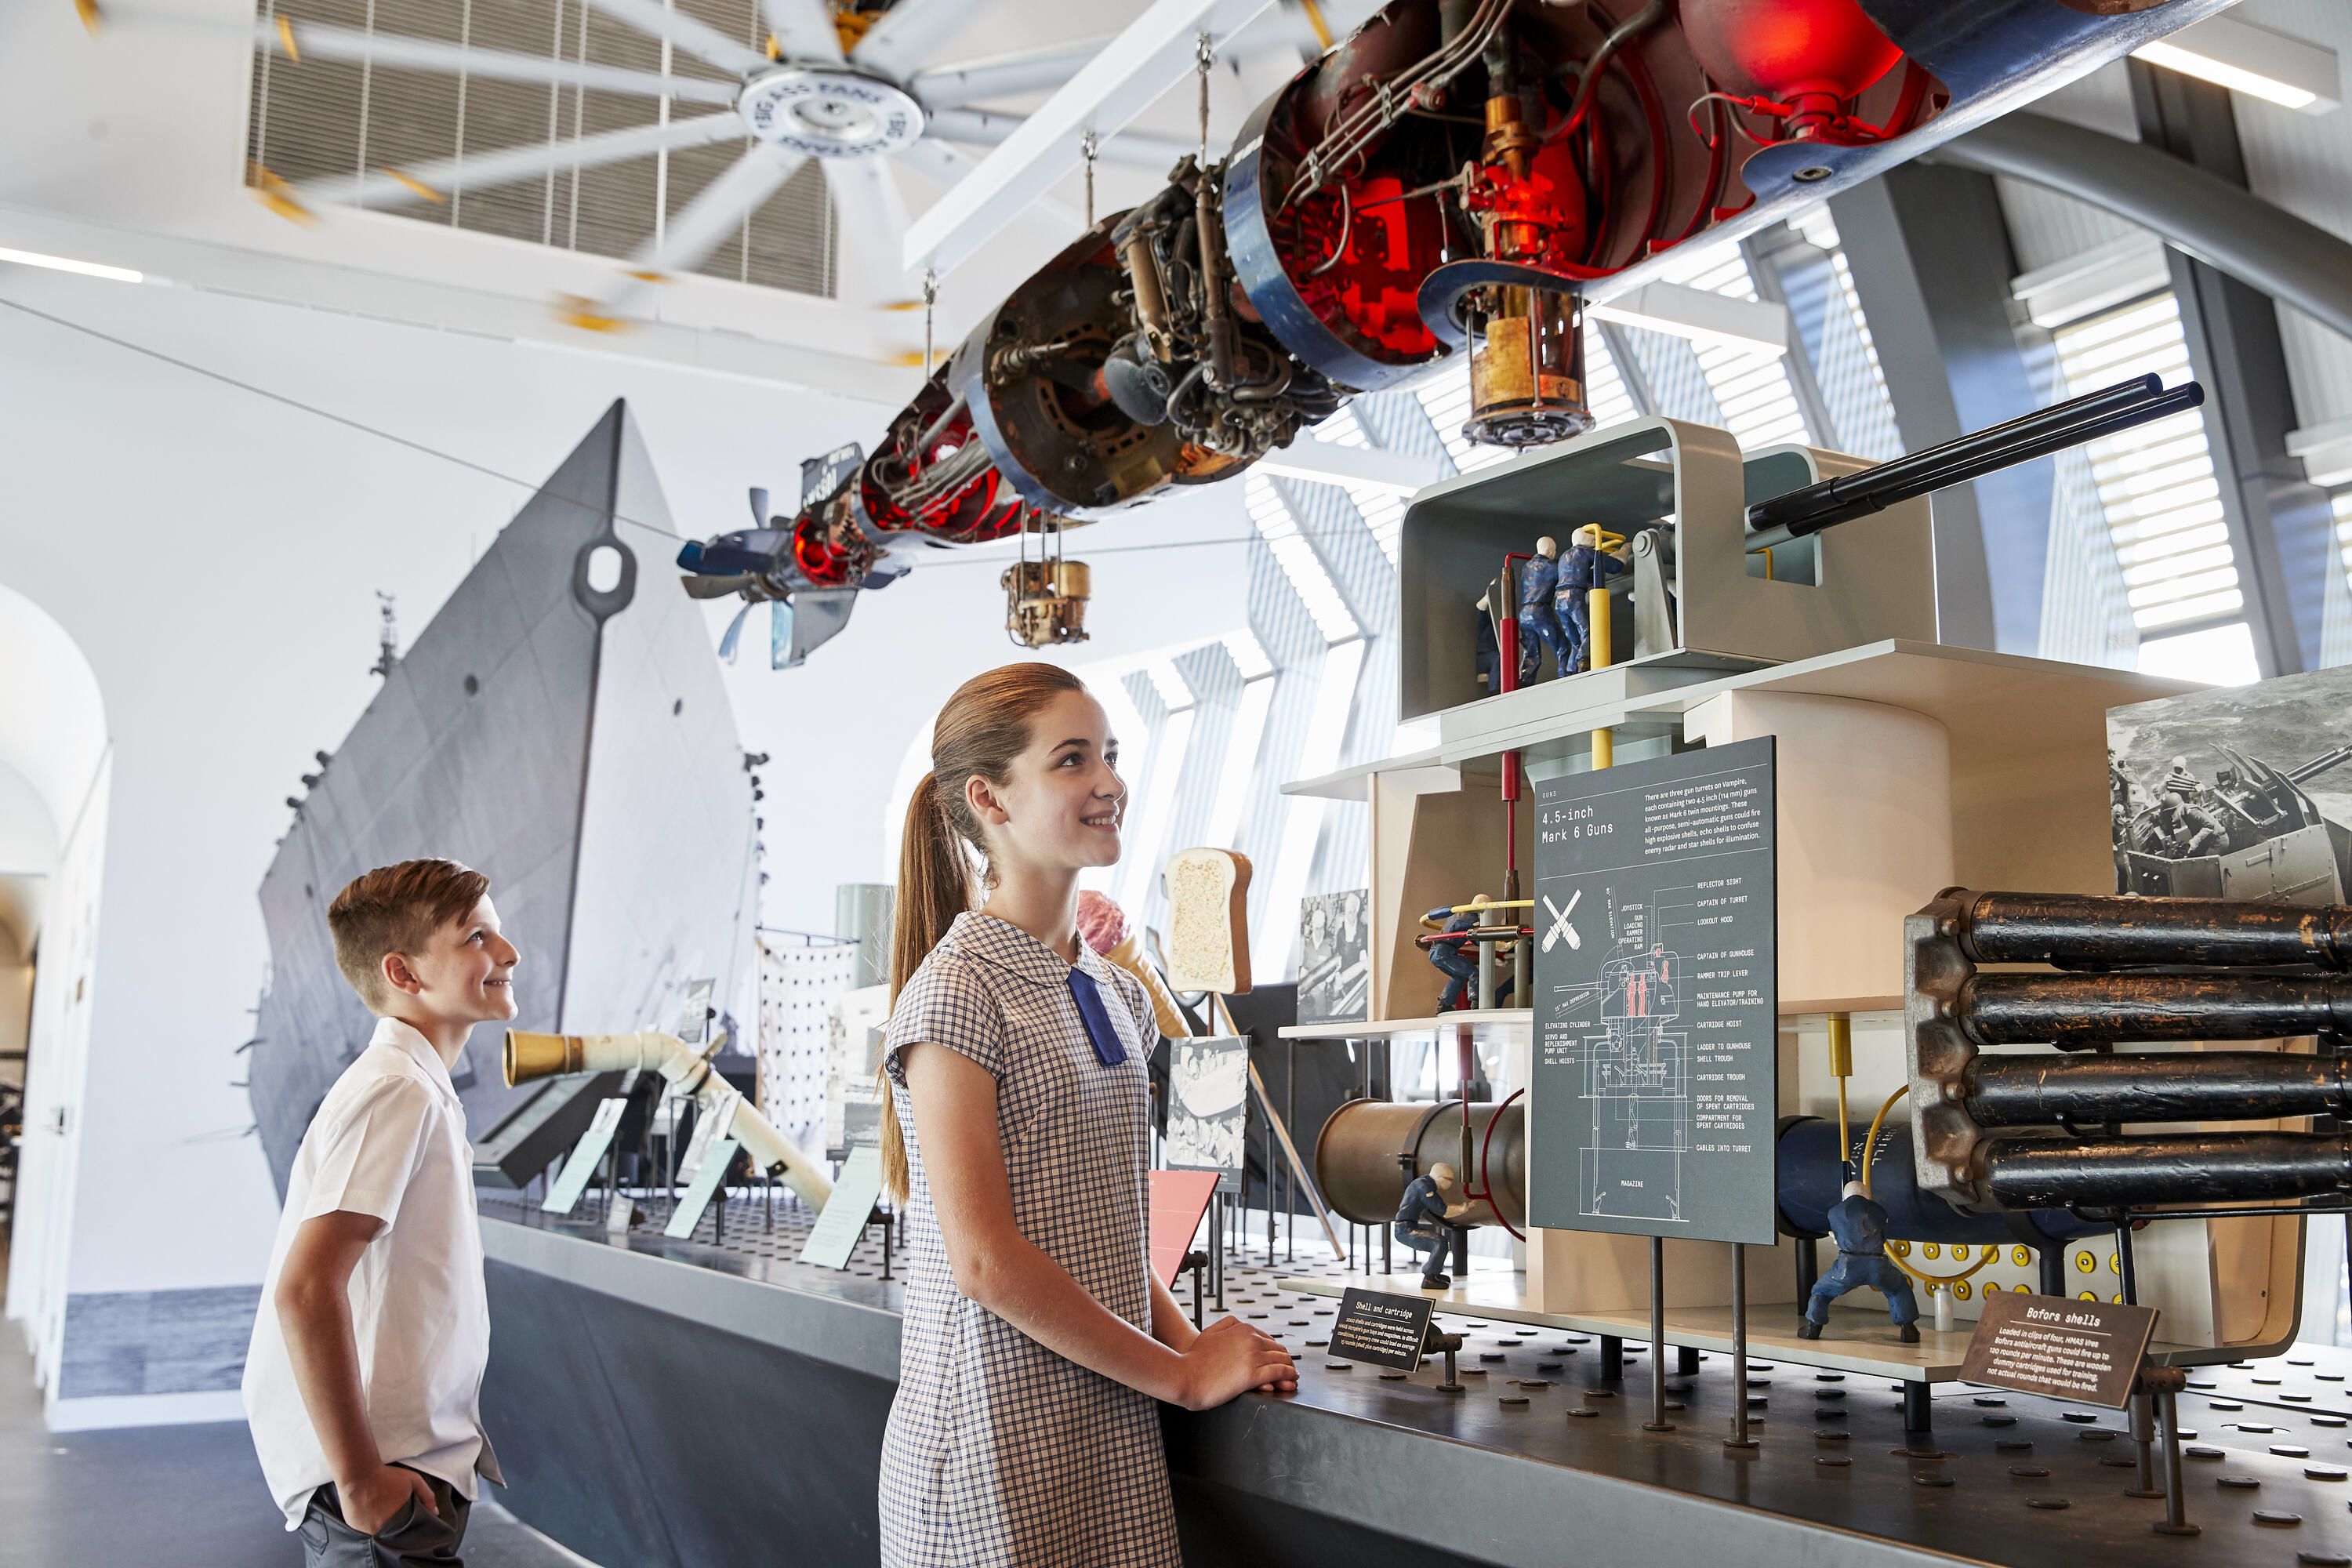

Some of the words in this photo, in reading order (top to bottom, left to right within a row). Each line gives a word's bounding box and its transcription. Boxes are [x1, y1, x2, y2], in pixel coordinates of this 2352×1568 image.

[1542, 790, 1556, 799] GUNS
[1684, 788, 1694, 797] gun
[1695, 784, 1714, 793] turrets
[1645, 804, 1657, 812] each
[1657, 800, 1685, 810] containing
[1730, 789, 1743, 798] mm)
[1743, 788, 1757, 797] guns
[1542, 805, 1593, 825] 4.5-inch
[1669, 810, 1682, 818] Mark
[1687, 808, 1700, 816] twin
[1700, 804, 1730, 813] mountings.
[1677, 815, 1719, 829] semi-automatic
[1720, 814, 1733, 823] guns
[1734, 810, 1750, 819] could
[1542, 828, 1567, 844] Mark
[1574, 826, 1580, 838] 6
[1587, 823, 1613, 837] Guns
[1645, 836, 1656, 845] high
[1657, 833, 1681, 843] explosive
[1713, 825, 1730, 833] shells
[1737, 821, 1759, 830] confuse
[1662, 844, 1677, 852] radar
[1677, 841, 1687, 850] and
[1700, 838, 1715, 847] shells
[1726, 832, 1760, 843] illumination.
[1697, 880, 1724, 889] REFLECTOR
[1726, 877, 1742, 886] SIGHT
[1621, 903, 1643, 912] JOYSTICK
[1697, 898, 1719, 907] CAPTAIN
[1730, 895, 1748, 904] TURRET
[1624, 921, 1643, 930] LOADING
[1697, 916, 1718, 926] LOOKOUT
[1618, 936, 1643, 945] OPERATING
[1697, 952, 1719, 960] CAPTAIN
[1729, 949, 1754, 957] GUNHOUSE
[1697, 991, 1730, 1000] MAINTENANCE
[1711, 997, 1764, 1007] ELEVATOR/TRAINING
[1356, 1301, 1371, 1311] Shell
[1385, 1308, 1413, 1319] cartridge
[2027, 1307, 2060, 1322] Bofors
[2065, 1312, 2100, 1327] shells
[1999, 1327, 2021, 1337] Loaded
[2027, 1330, 2043, 1341] clips
[2065, 1336, 2085, 1346] HMAS
[1994, 1337, 2014, 1346] Bofors
[2013, 1340, 2047, 1351] antiaircraft
[2062, 1348, 2081, 1356] could
[2080, 1348, 2092, 1358] fire
[1993, 1357, 2016, 1369] dummy
[2015, 1362, 2046, 1373] cartridges
[2046, 1367, 2062, 1375] used
[2062, 1367, 2072, 1376] for
[1999, 1348, 2021, 1358] rounds
[2031, 1353, 2055, 1363] minute.
[2056, 1356, 2074, 1367] These
[2086, 1362, 2112, 1371] wooden
[1998, 1370, 2017, 1378] actual
[2016, 1373, 2038, 1382] rounds
[2038, 1375, 2052, 1385] that
[2052, 1378, 2072, 1388] would
[2071, 1381, 2081, 1389] be
[2081, 1381, 2097, 1392] fired.
